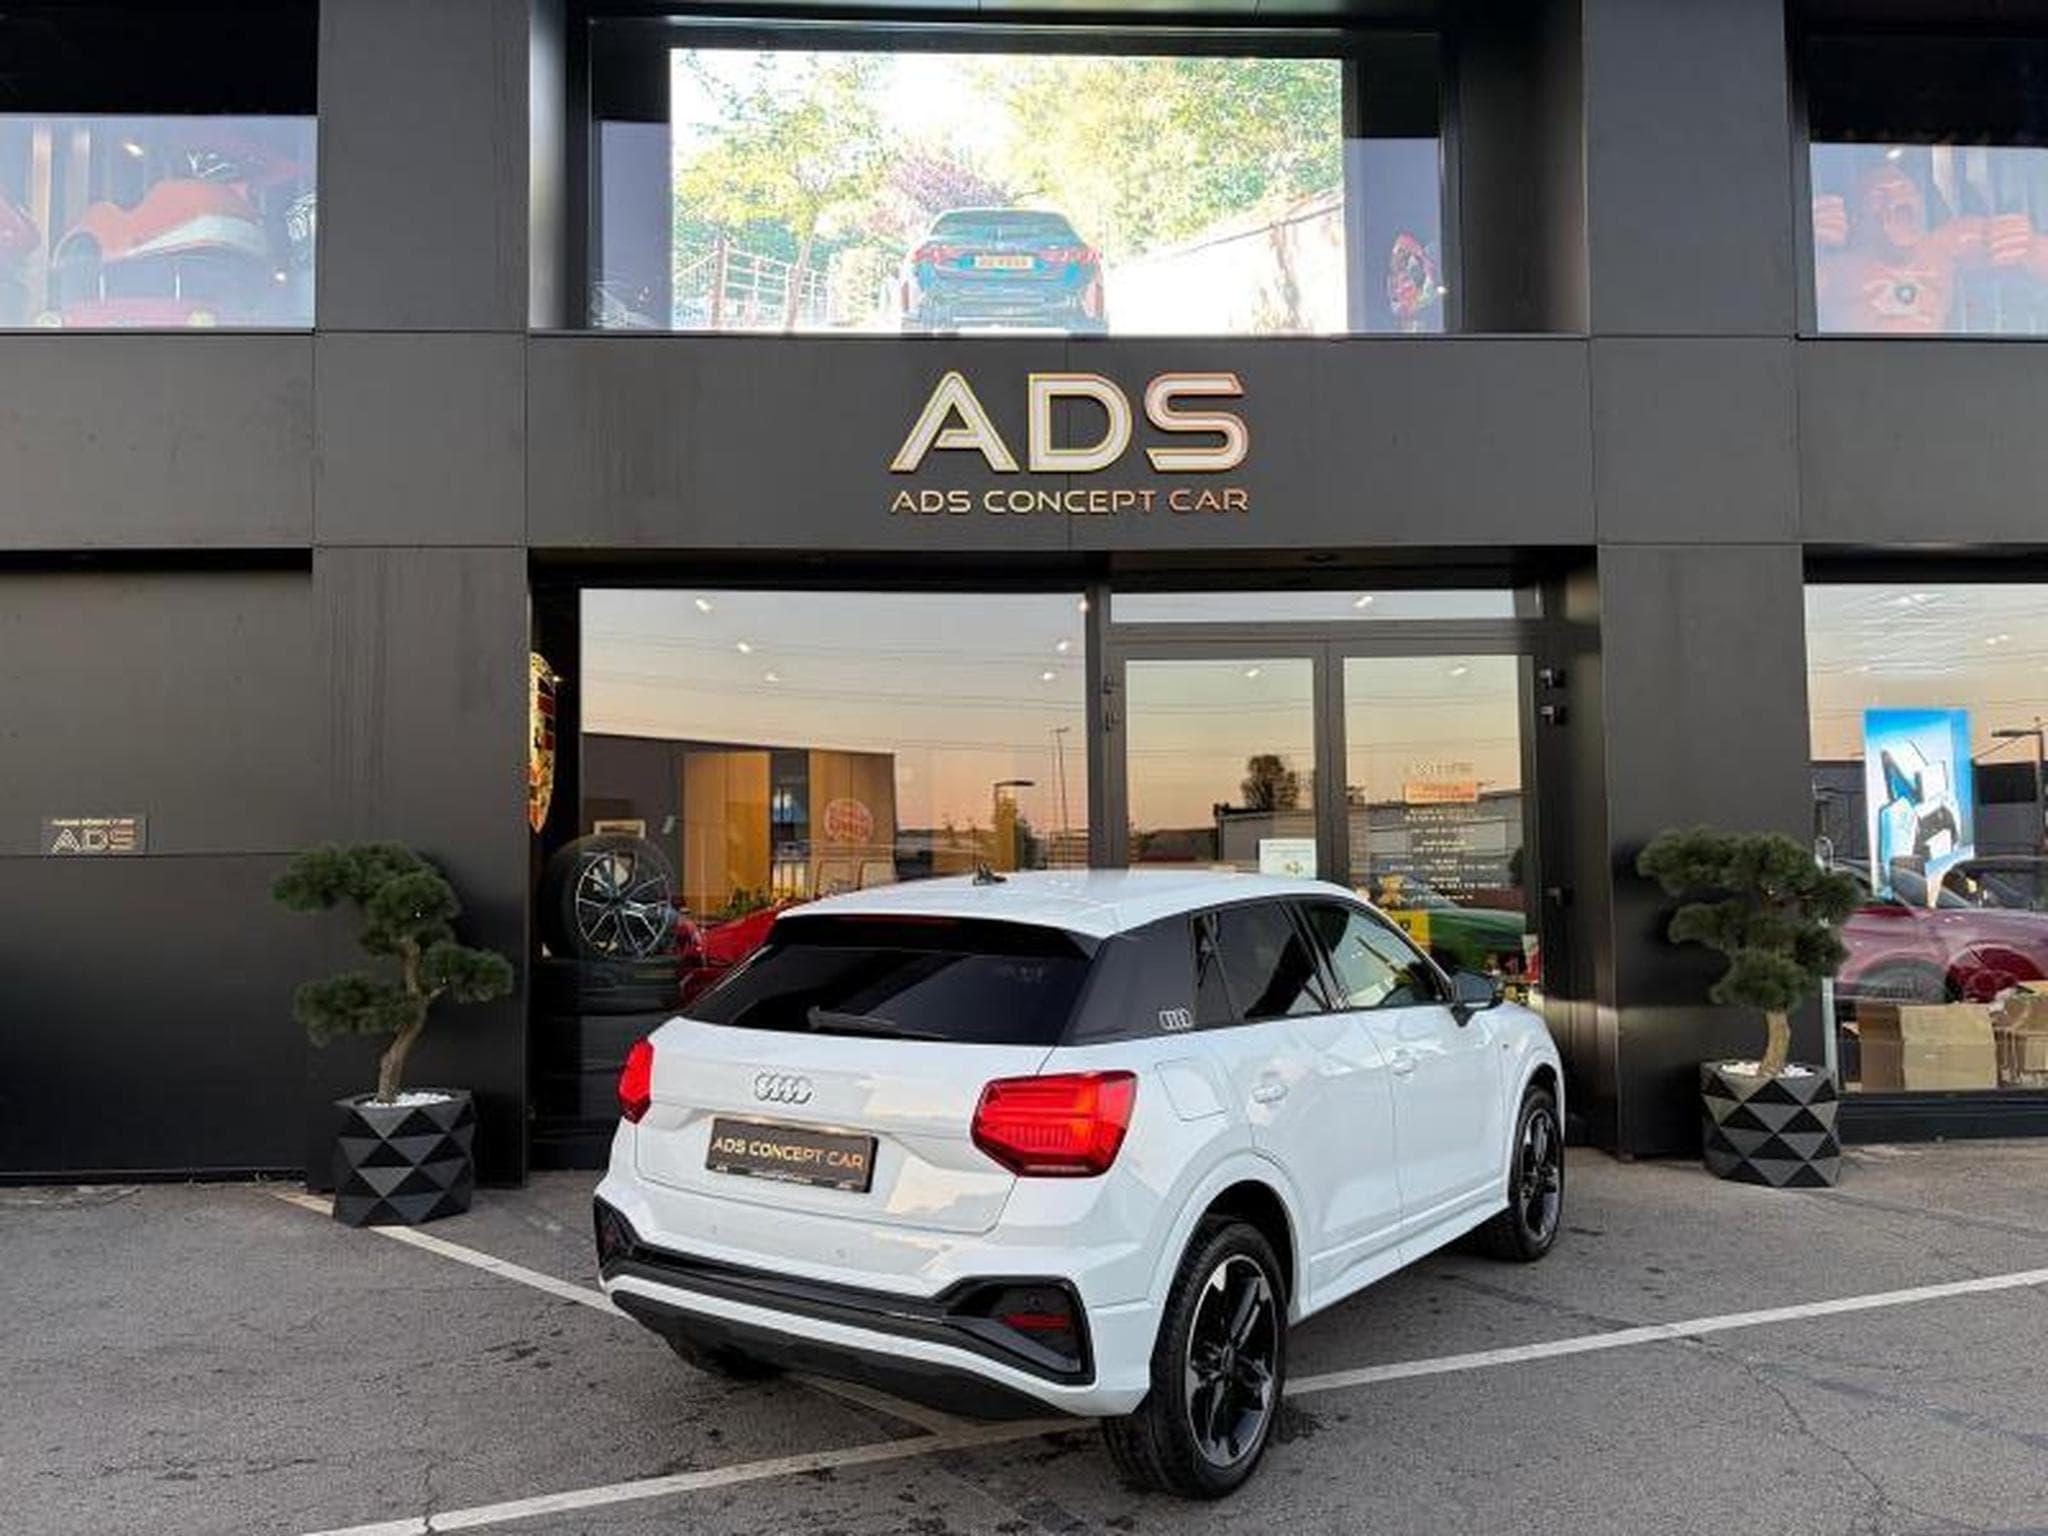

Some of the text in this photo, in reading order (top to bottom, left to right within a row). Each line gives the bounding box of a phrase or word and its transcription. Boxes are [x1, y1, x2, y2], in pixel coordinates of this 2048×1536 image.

[888, 371, 1249, 472] ADS
[890, 488, 1250, 514] ADS CONCEPT CAR
[51, 828, 135, 854] ADS
[712, 1136, 865, 1169] ADS CONCEPT CAR
